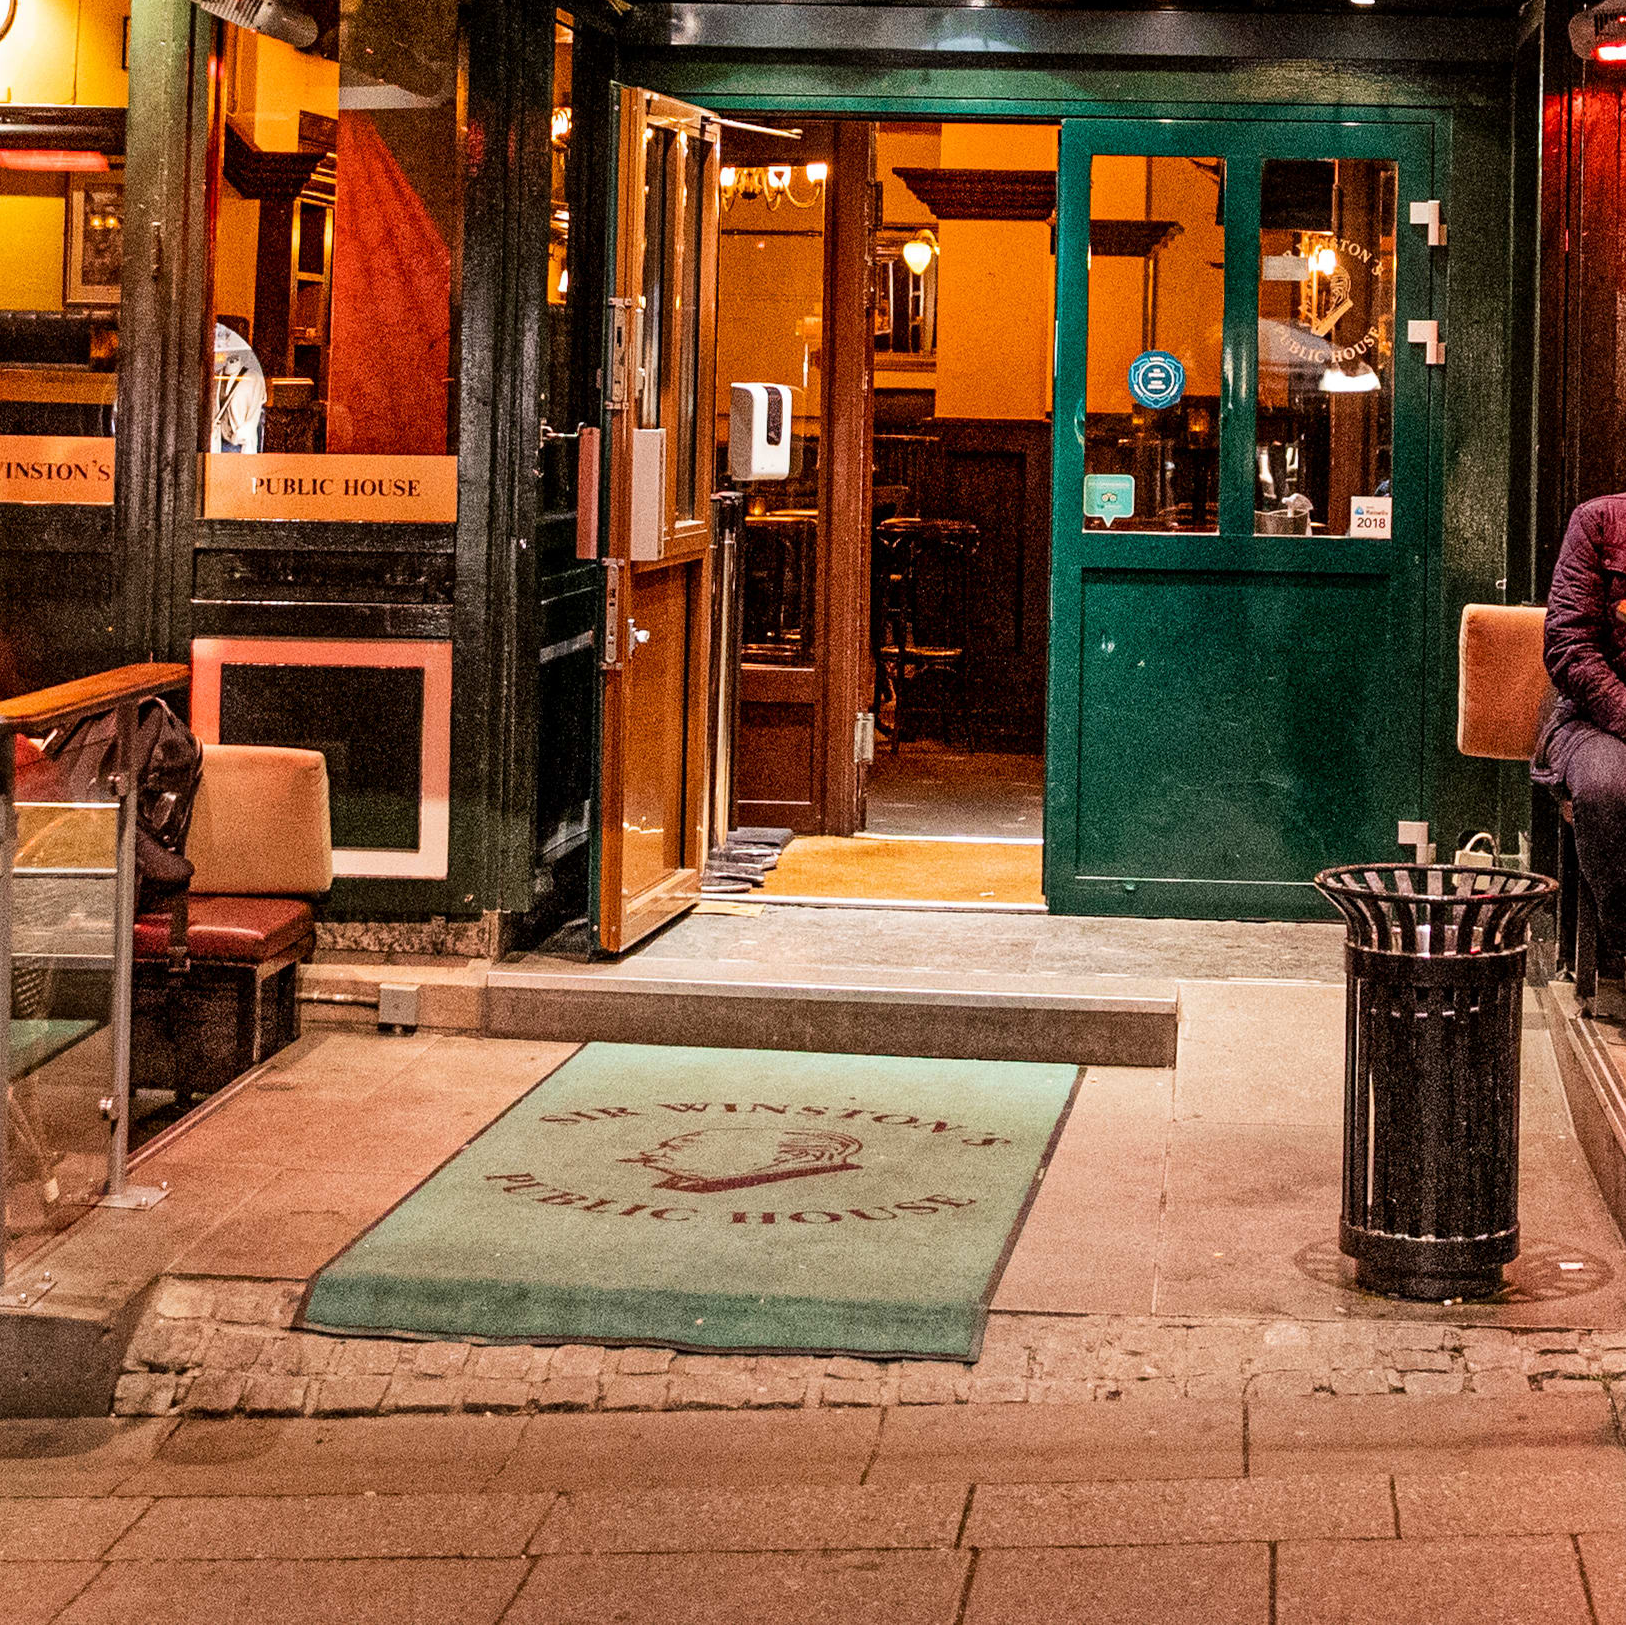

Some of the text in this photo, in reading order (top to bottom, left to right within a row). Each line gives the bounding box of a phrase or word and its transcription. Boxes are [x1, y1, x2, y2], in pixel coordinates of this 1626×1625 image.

[1331, 325, 1380, 363] HOUSE
[251, 477, 421, 498] PUBLIC HOUSE
[1357, 517, 1386, 529] 2018
[538, 1101, 1012, 1148] SIR WINSTON'S
[484, 1172, 977, 1225] PUBLIC HOUSE
